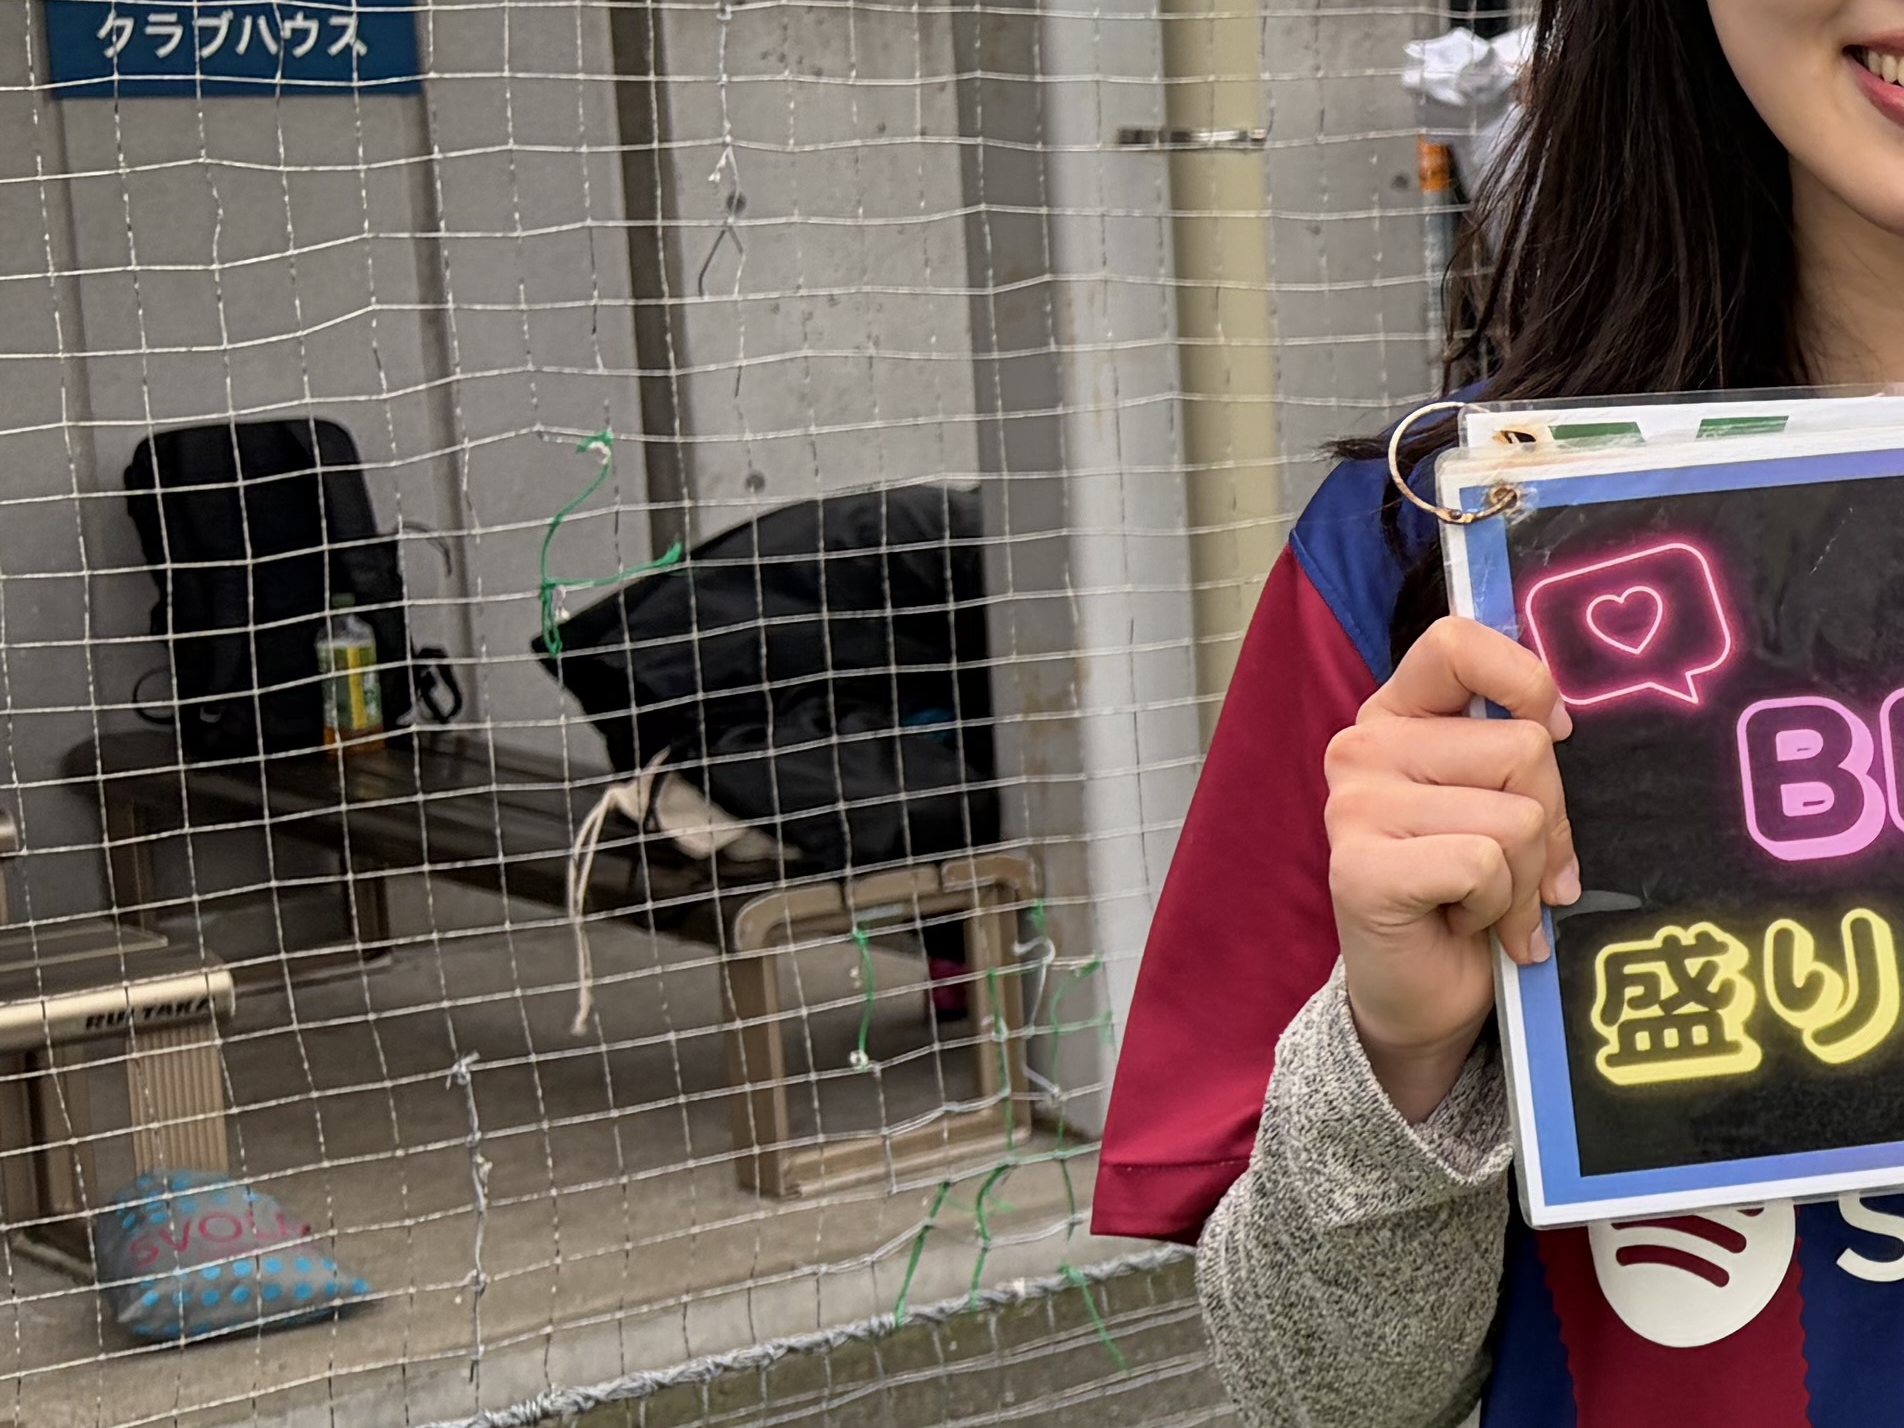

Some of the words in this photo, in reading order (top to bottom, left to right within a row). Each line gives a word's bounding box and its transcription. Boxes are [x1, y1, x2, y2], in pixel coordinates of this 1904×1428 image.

[97, 10, 368, 59] クラブハウス
